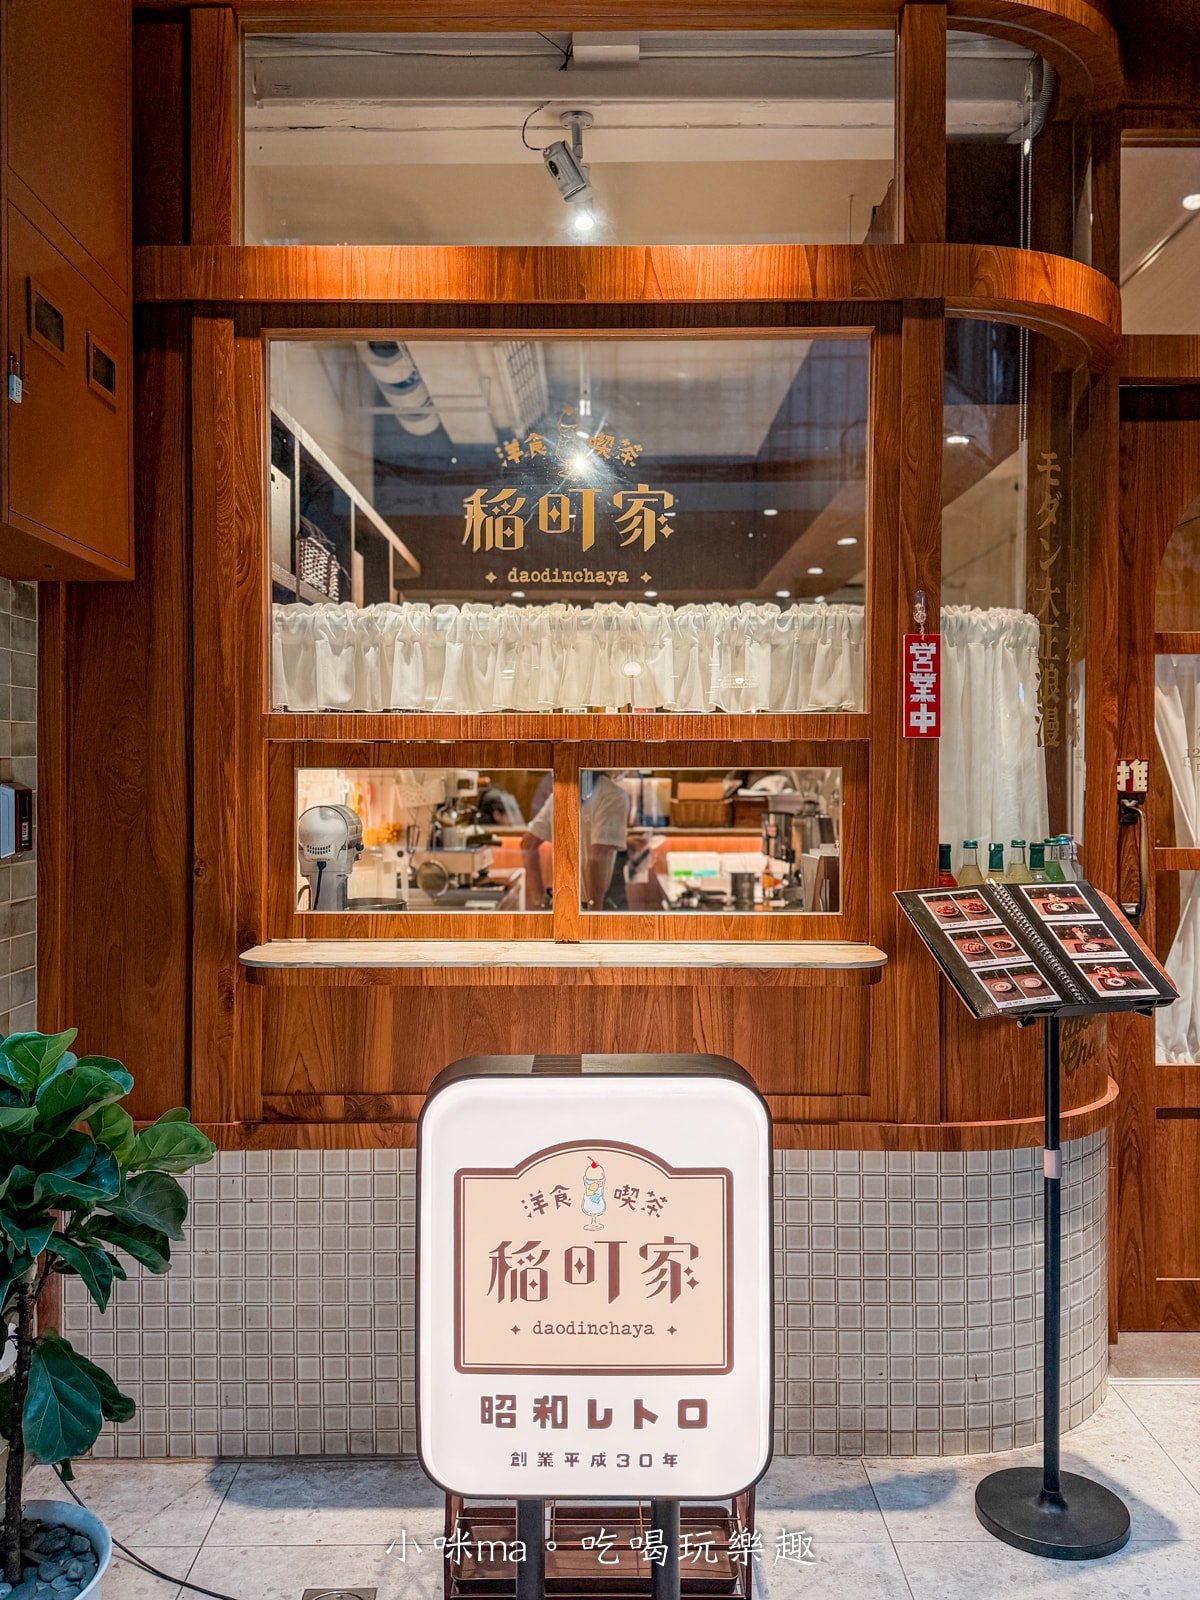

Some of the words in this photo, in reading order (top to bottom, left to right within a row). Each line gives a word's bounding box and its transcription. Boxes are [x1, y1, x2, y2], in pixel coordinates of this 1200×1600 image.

[495, 432, 548, 468] 洋食
[588, 431, 644, 468] 喫茶
[507, 567, 630, 586] daodinchaya
[909, 642, 937, 734] 営業中
[1116, 758, 1149, 792] 推
[520, 1184, 572, 1218] 洋食
[613, 1183, 668, 1218] 喫茶
[532, 1321, 655, 1338] daodinchaya
[480, 1394, 708, 1430] 昭和レトロ
[510, 1451, 678, 1468] 創業平成30年
